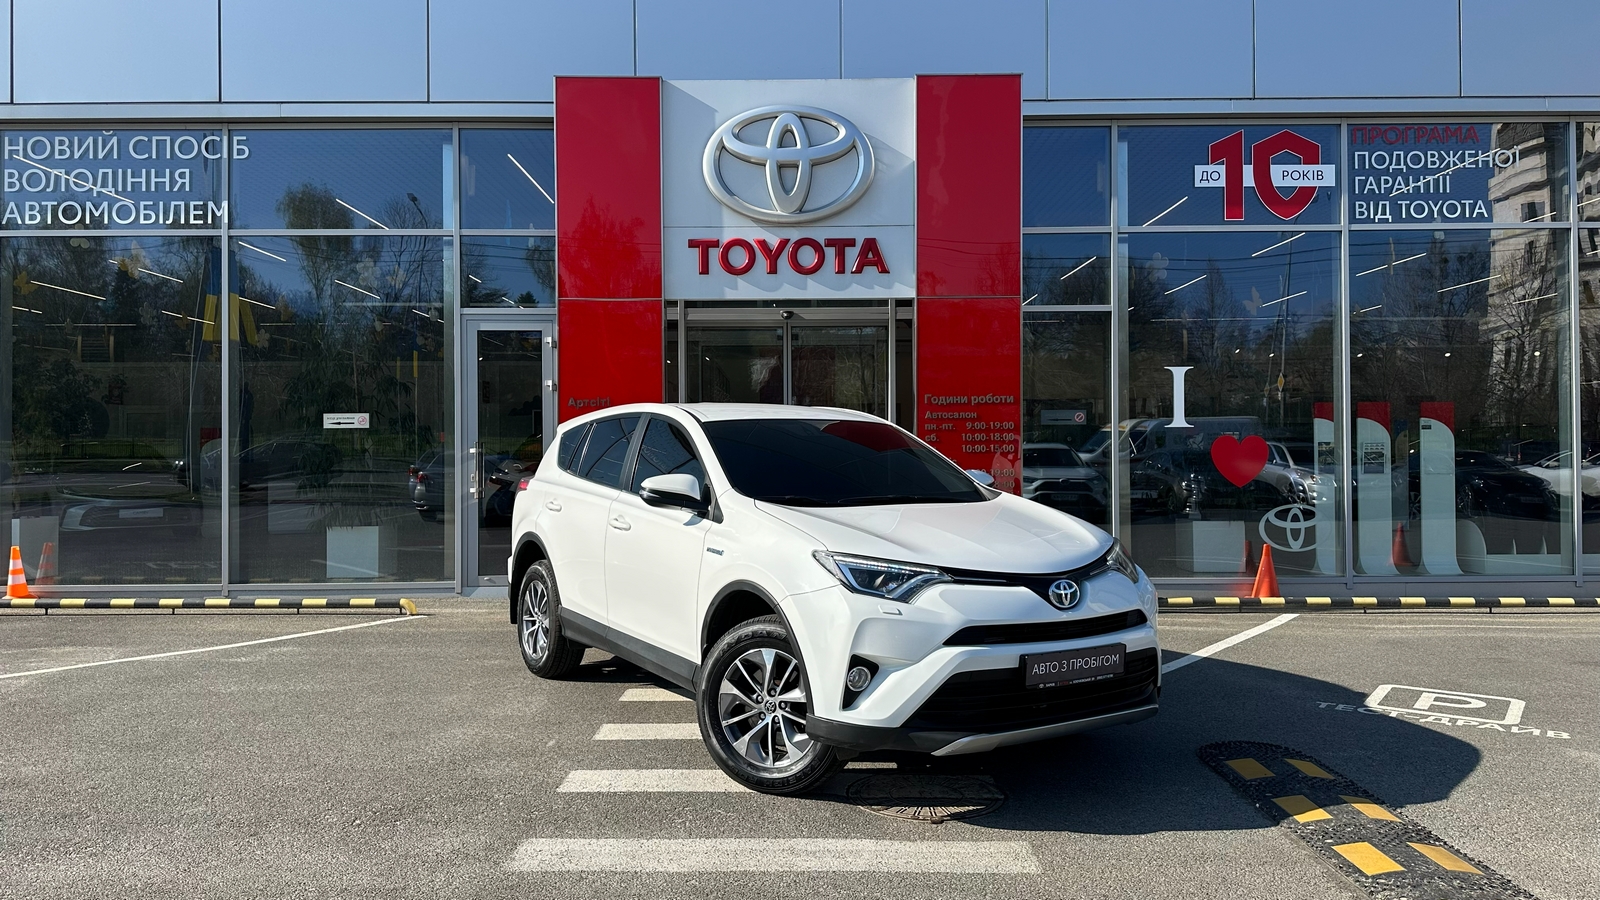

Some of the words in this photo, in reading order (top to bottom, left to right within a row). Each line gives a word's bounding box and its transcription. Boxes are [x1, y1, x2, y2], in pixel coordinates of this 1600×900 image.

[4, 130, 118, 159] НОВИЙ
[129, 135, 250, 159] СПОСІБ
[1352, 125, 1480, 144] ПРОГРАМА
[1354, 146, 1521, 172] ПОДОВЖЕНОЇ
[4, 168, 190, 197] ВОЛОДІННЯ
[1200, 170, 1220, 183] ДО
[1209, 129, 1321, 220] 10
[1282, 170, 1324, 181] РОКІВ
[1354, 171, 1452, 194] ГАРАНТІЇ
[2, 200, 229, 225] АВТОМОБІЛЕМ
[1355, 201, 1392, 222] ВІД
[1397, 200, 1488, 219] TOYOTA
[688, 237, 890, 275] TOYOTA
[924, 394, 968, 405] Години
[971, 393, 1014, 406] роботи
[1164, 366, 1194, 427] I
[925, 411, 977, 419] Автосалон
[965, 421, 1015, 430] 9:00-19:00
[924, 434, 939, 442] сб.
[961, 433, 1015, 441] 10:00-18:00
[961, 444, 1015, 453] 10:00-15:00
[1032, 661, 1059, 675] АВТО
[1069, 654, 1119, 670] ПРОБІГОМ
[1316, 702, 1571, 739] ТЕСТ-ДРАЙВ
